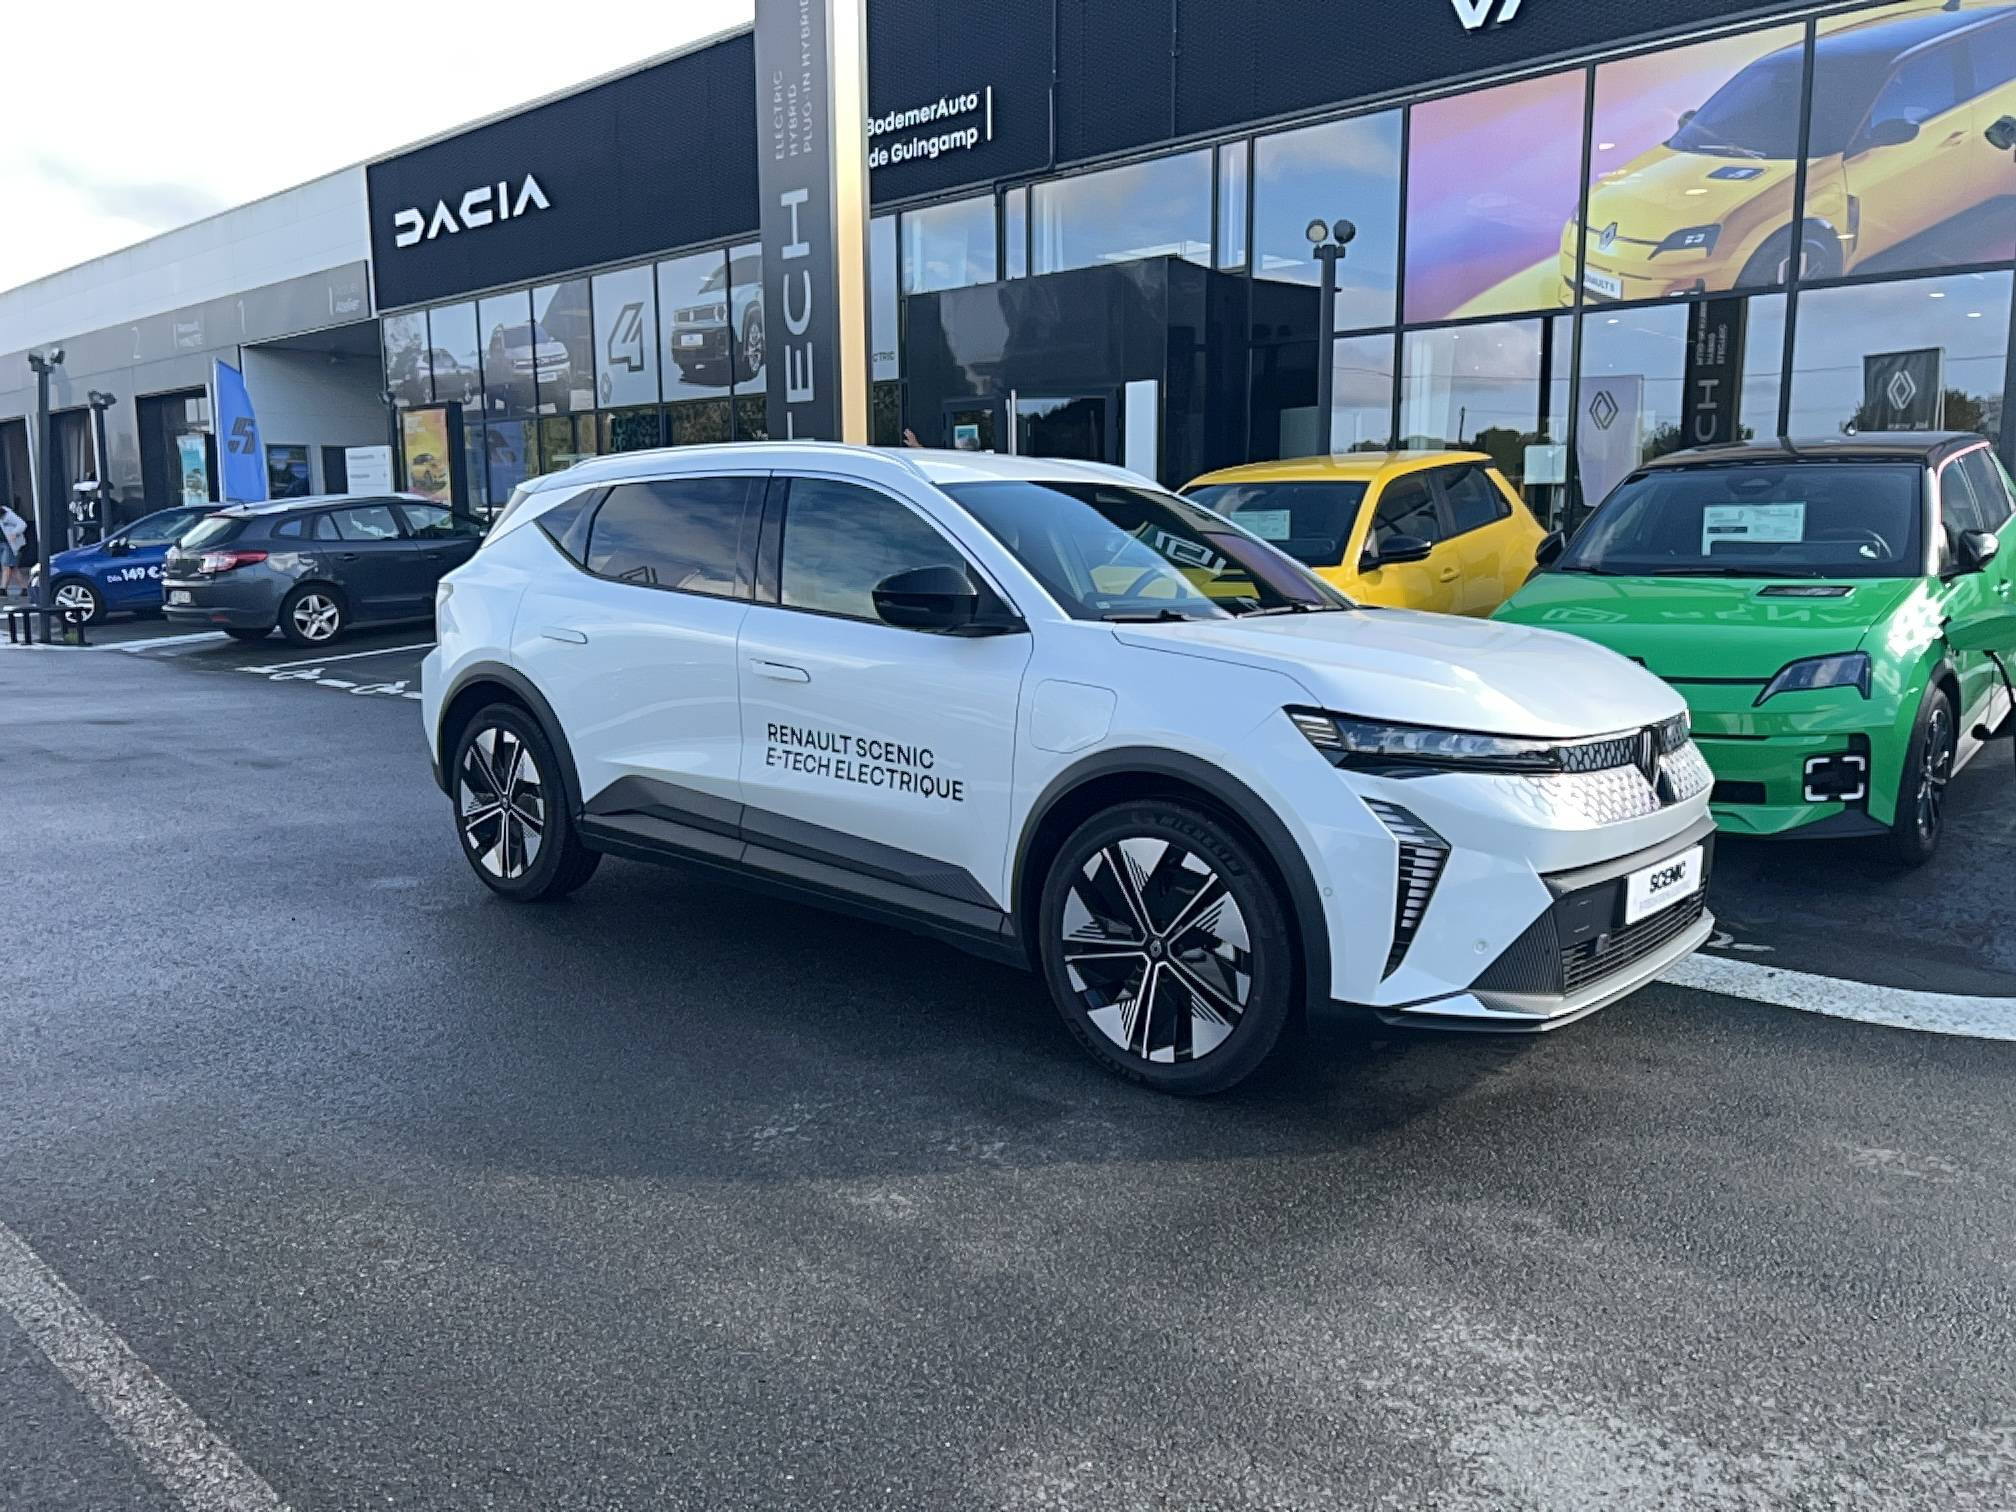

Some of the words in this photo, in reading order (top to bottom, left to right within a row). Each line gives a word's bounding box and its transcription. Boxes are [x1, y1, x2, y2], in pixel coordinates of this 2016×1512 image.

[773, 69, 785, 160] ELECTRIC
[788, 83, 799, 157] HYBRID
[868, 146, 889, 169] de
[890, 126, 979, 159] Guingamp
[394, 172, 551, 248] DACIA
[121, 566, 146, 582] 149
[767, 722, 852, 755] RENAULT
[855, 737, 935, 770] SCENIC
[765, 746, 831, 778] E-TECH
[834, 759, 965, 802] ELECTRIQUE
[1649, 860, 1687, 894] SCENIC
